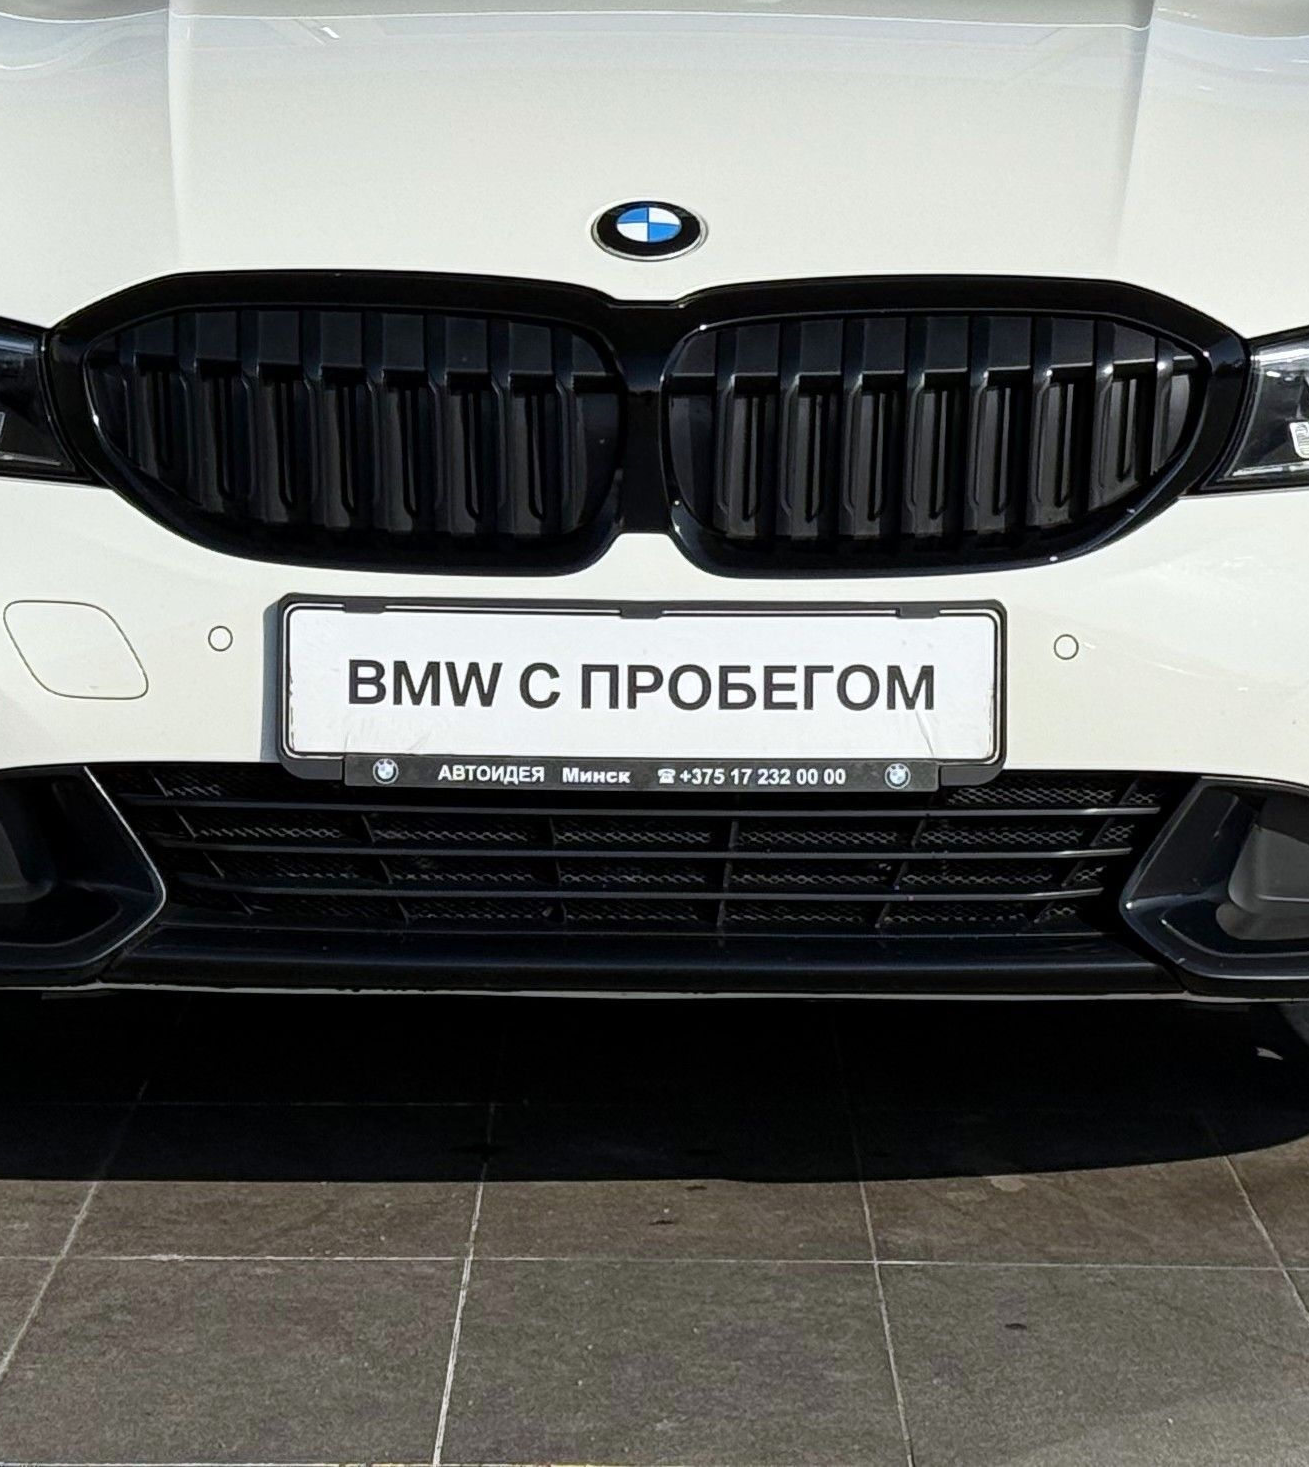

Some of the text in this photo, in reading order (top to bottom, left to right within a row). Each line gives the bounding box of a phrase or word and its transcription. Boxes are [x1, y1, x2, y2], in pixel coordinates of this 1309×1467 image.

[348, 658, 935, 712] BMW С ПРОБЕГОМ
[437, 764, 847, 786] АВТОИДЕЯ Минск +375 17 232 00 00
